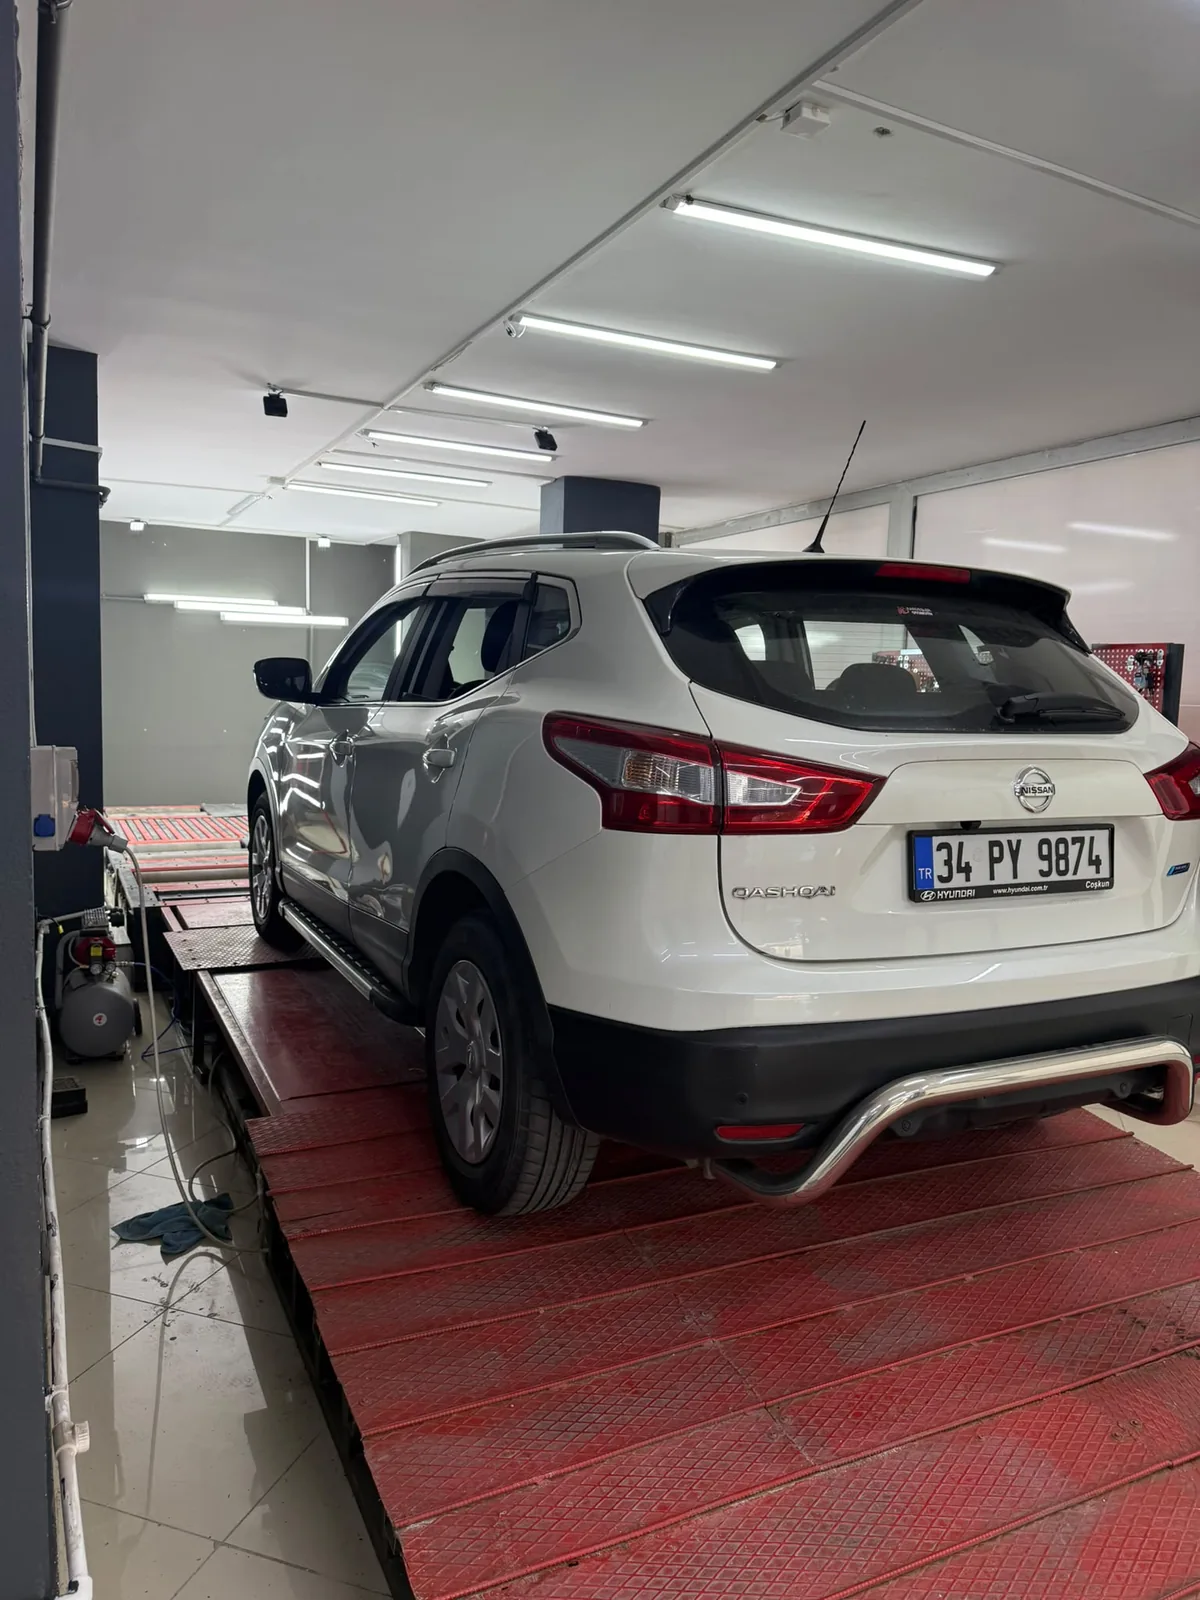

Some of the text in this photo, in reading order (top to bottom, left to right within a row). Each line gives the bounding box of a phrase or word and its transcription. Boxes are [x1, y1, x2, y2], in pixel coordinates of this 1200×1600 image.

[1021, 786, 1053, 795] NISSAN
[936, 836, 1102, 883] 34 PY 9874
[918, 868, 933, 880] TR
[731, 885, 836, 900] QASHQAI
[937, 880, 1110, 899] HYUNDAI www.hyundai.com.tr Coşkun
